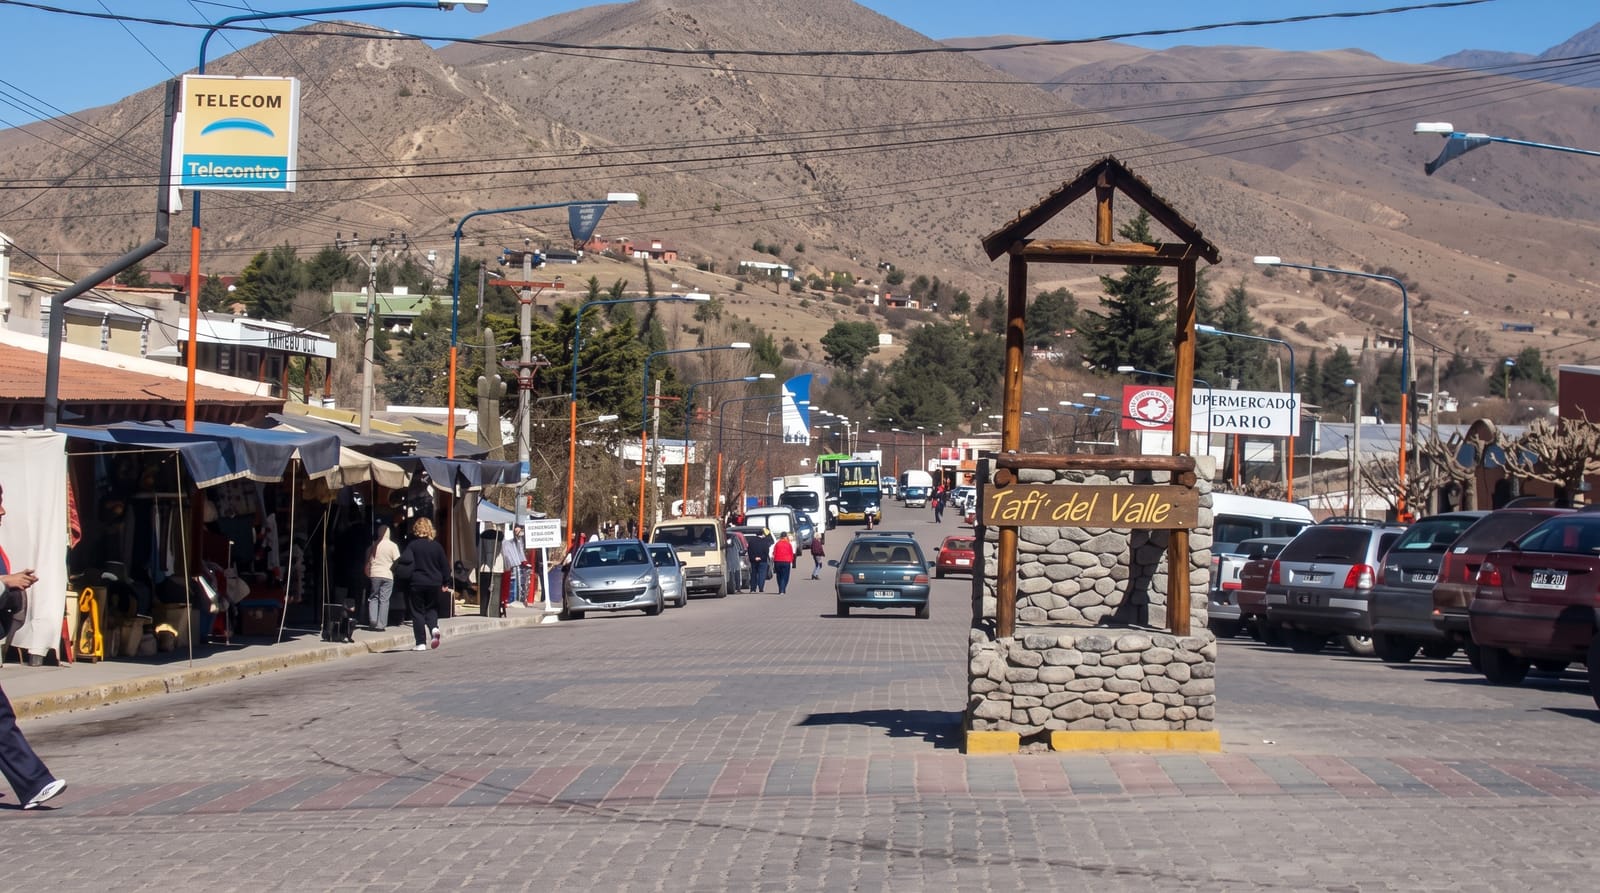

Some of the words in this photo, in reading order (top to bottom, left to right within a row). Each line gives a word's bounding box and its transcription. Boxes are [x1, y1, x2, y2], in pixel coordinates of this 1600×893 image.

[195, 94, 282, 108] TELECOM
[1213, 414, 1271, 430] DARIO
[1051, 492, 1099, 521] del
[1112, 492, 1170, 524] Valle
